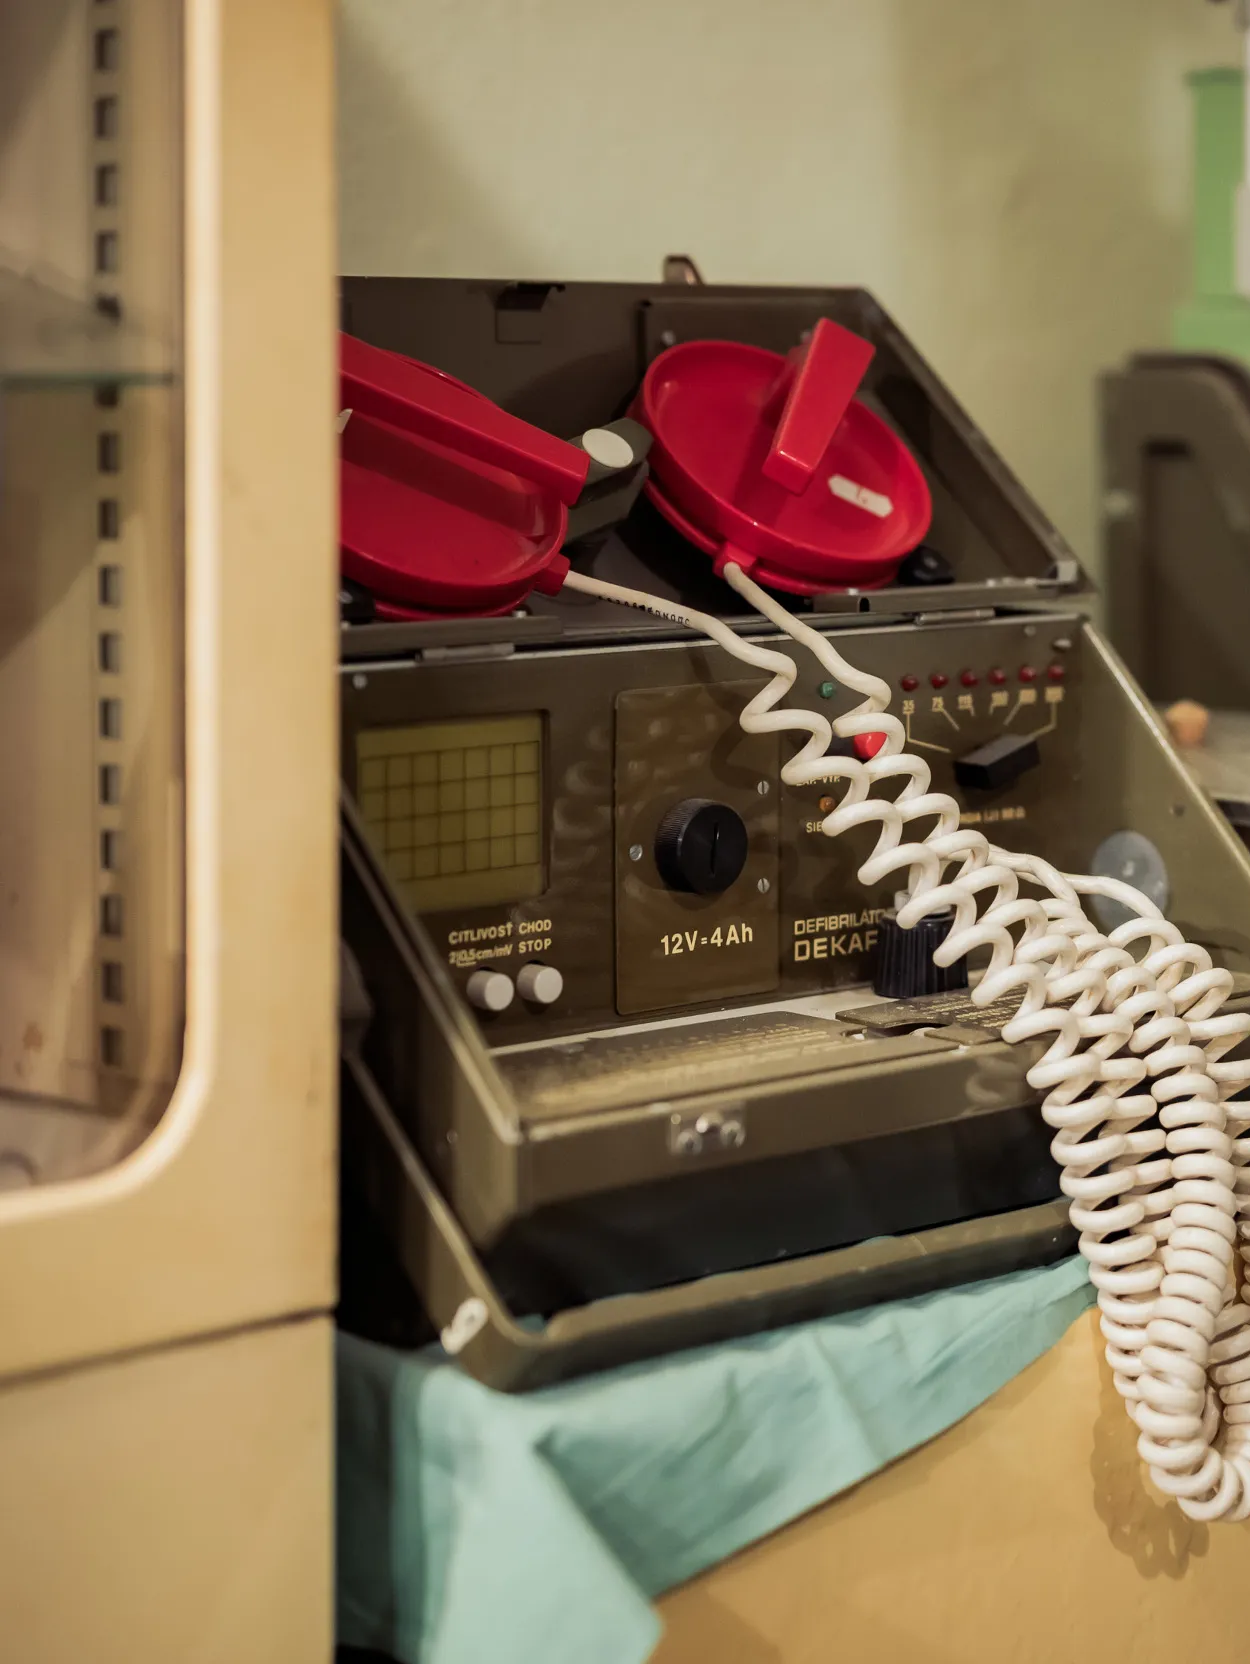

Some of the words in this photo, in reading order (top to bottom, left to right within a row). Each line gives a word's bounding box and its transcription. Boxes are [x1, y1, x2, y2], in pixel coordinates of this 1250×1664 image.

[518, 919, 552, 935] CHOD
[518, 938, 552, 954] STOP
[794, 929, 878, 962] DEKAF
